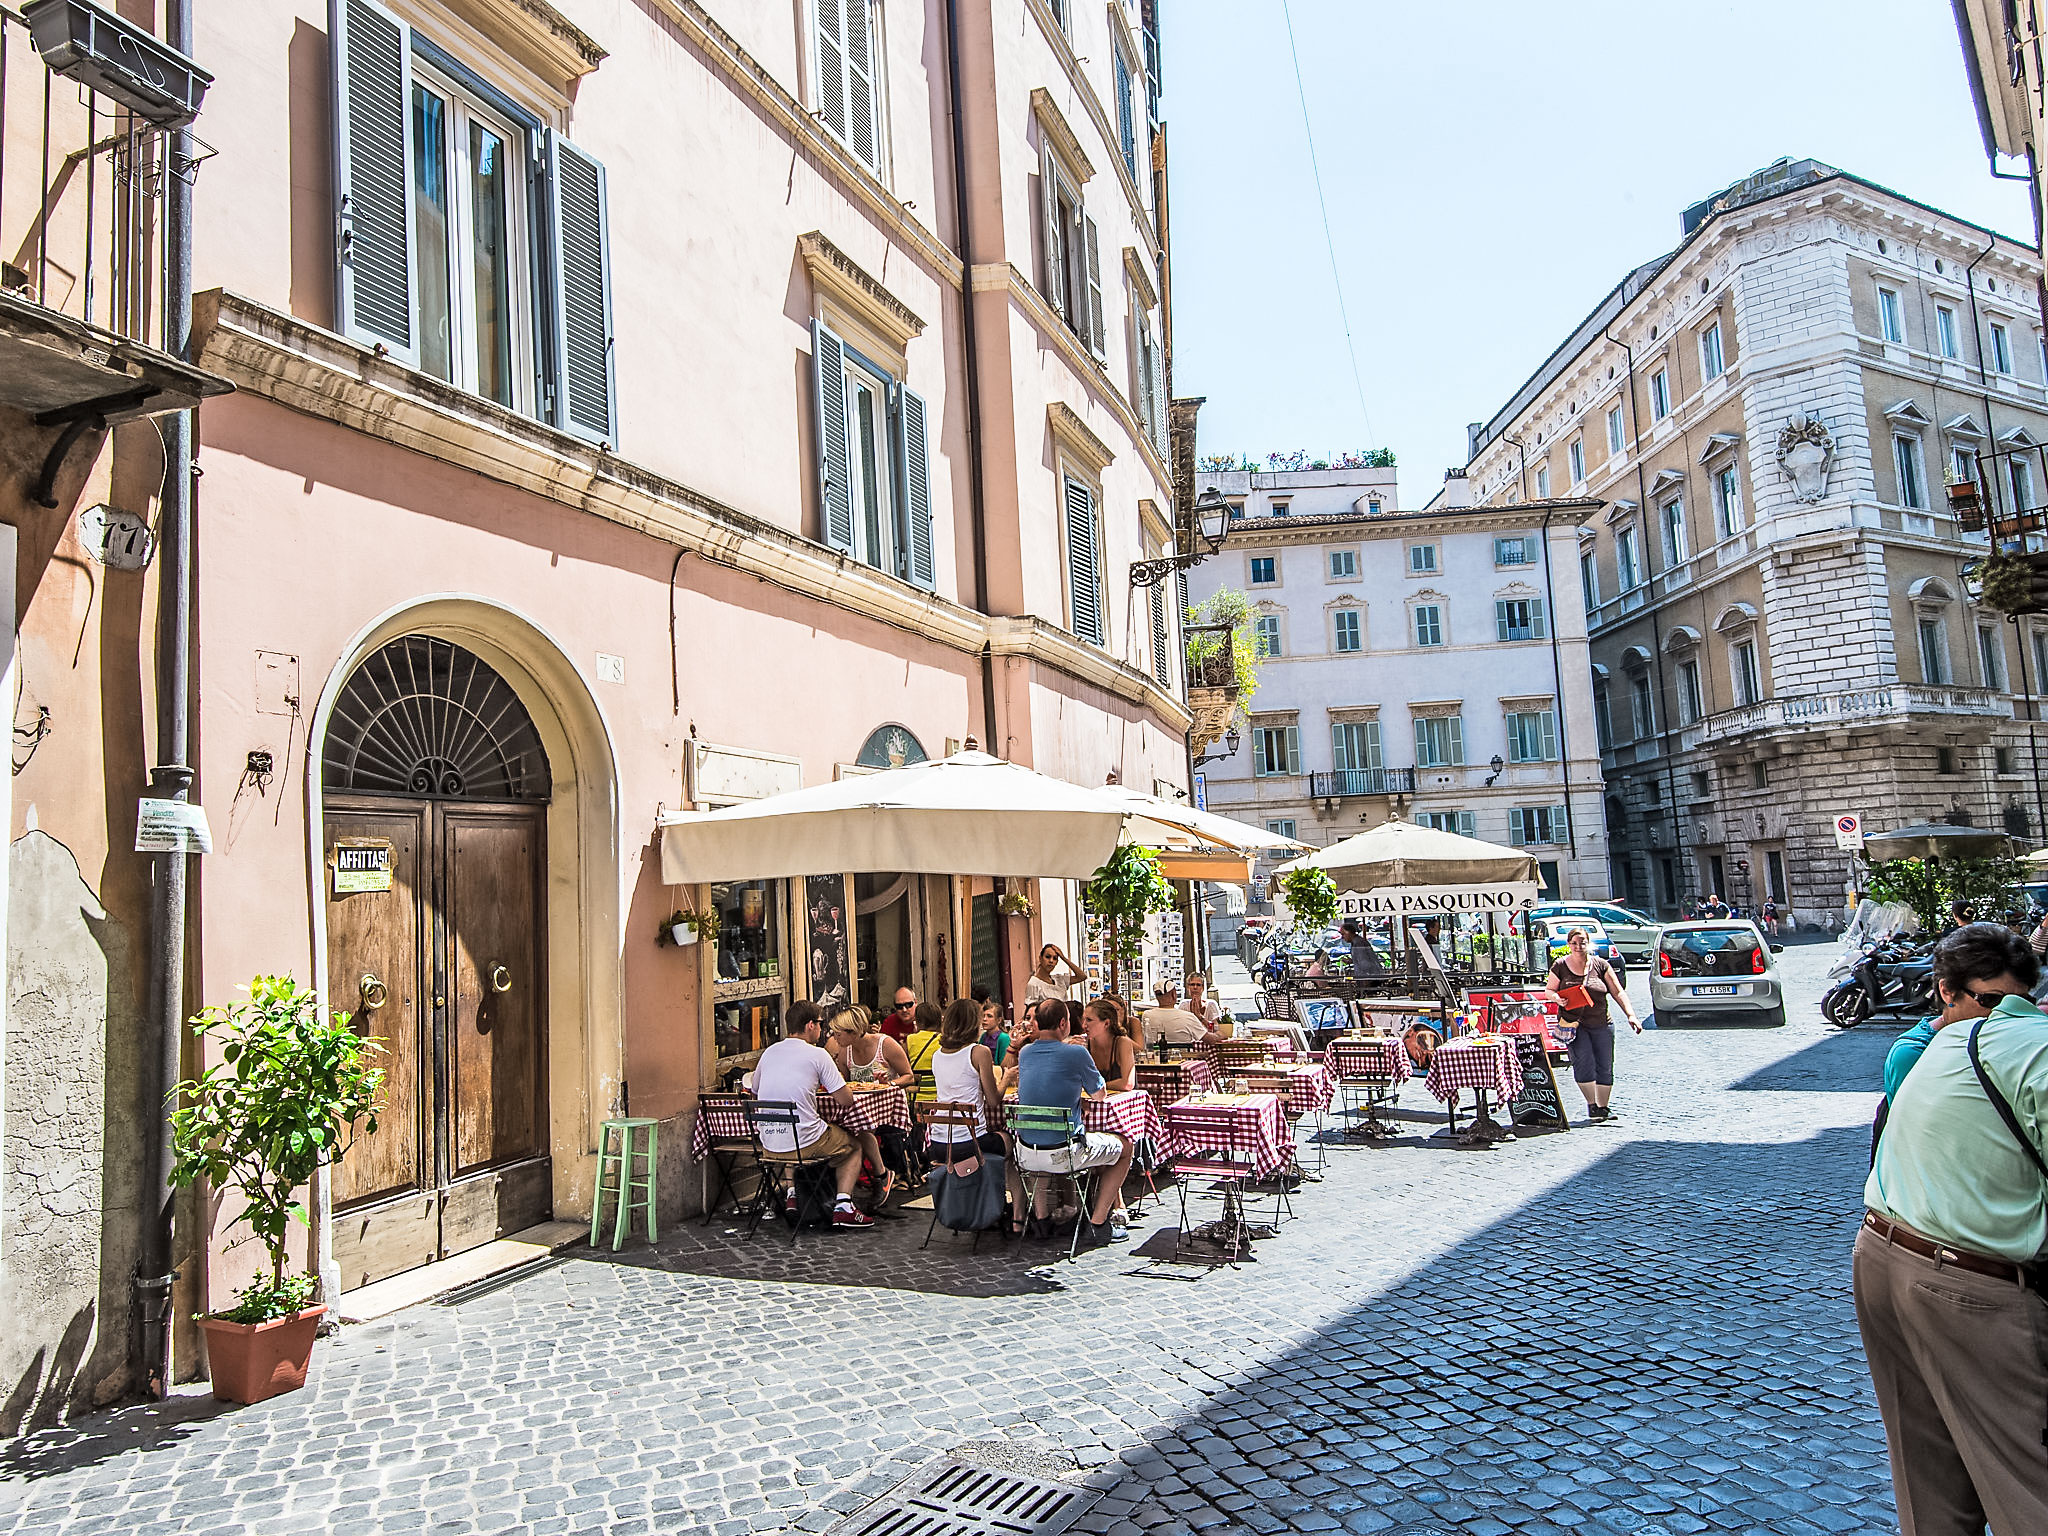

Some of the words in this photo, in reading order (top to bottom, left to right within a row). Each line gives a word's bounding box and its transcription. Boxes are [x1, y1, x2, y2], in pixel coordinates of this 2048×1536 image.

[96, 516, 139, 555] 77
[340, 850, 389, 868] AFFITTASI
[1400, 891, 1514, 912] PASQUINO
